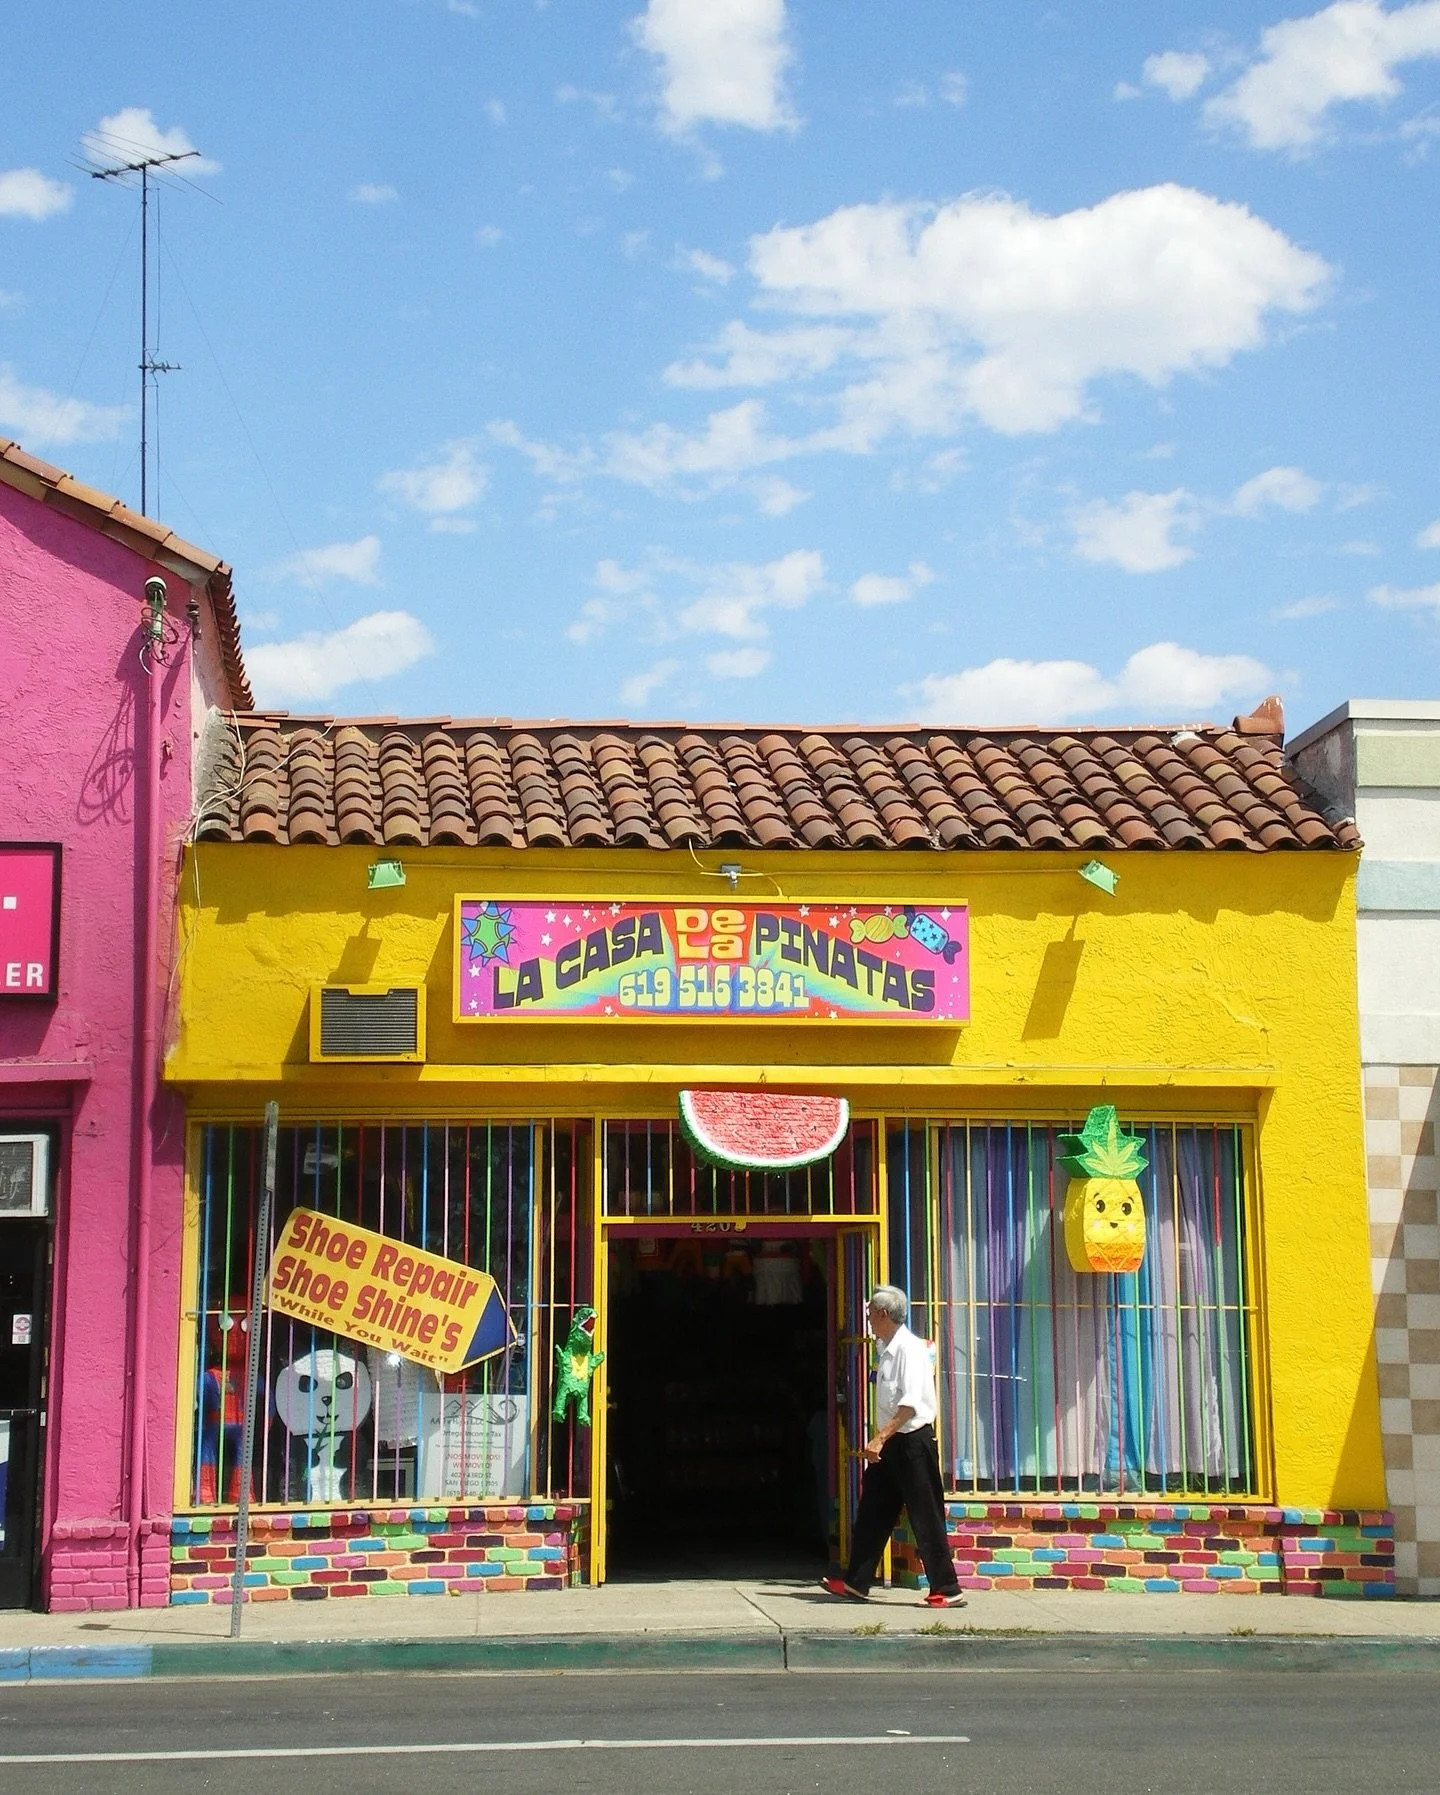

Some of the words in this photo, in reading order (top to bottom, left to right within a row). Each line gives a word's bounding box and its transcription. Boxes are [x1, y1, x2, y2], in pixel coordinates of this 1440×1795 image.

[0, 962, 43, 987] ER
[493, 957, 544, 1010] LA
[555, 911, 664, 990] CASA
[755, 912, 935, 1012] PINATAS
[618, 966, 671, 1008] 619
[679, 964, 731, 1008] 516
[738, 965, 810, 1008] 3841
[287, 1215, 367, 1270] Shoe
[371, 1243, 479, 1310] Repair
[691, 1222, 747, 1232] 420
[271, 1292, 335, 1326] "While
[344, 1320, 381, 1344] You
[391, 1338, 448, 1364] Wait"
[272, 1255, 349, 1311] Shoe
[352, 1284, 463, 1353] Shine's
